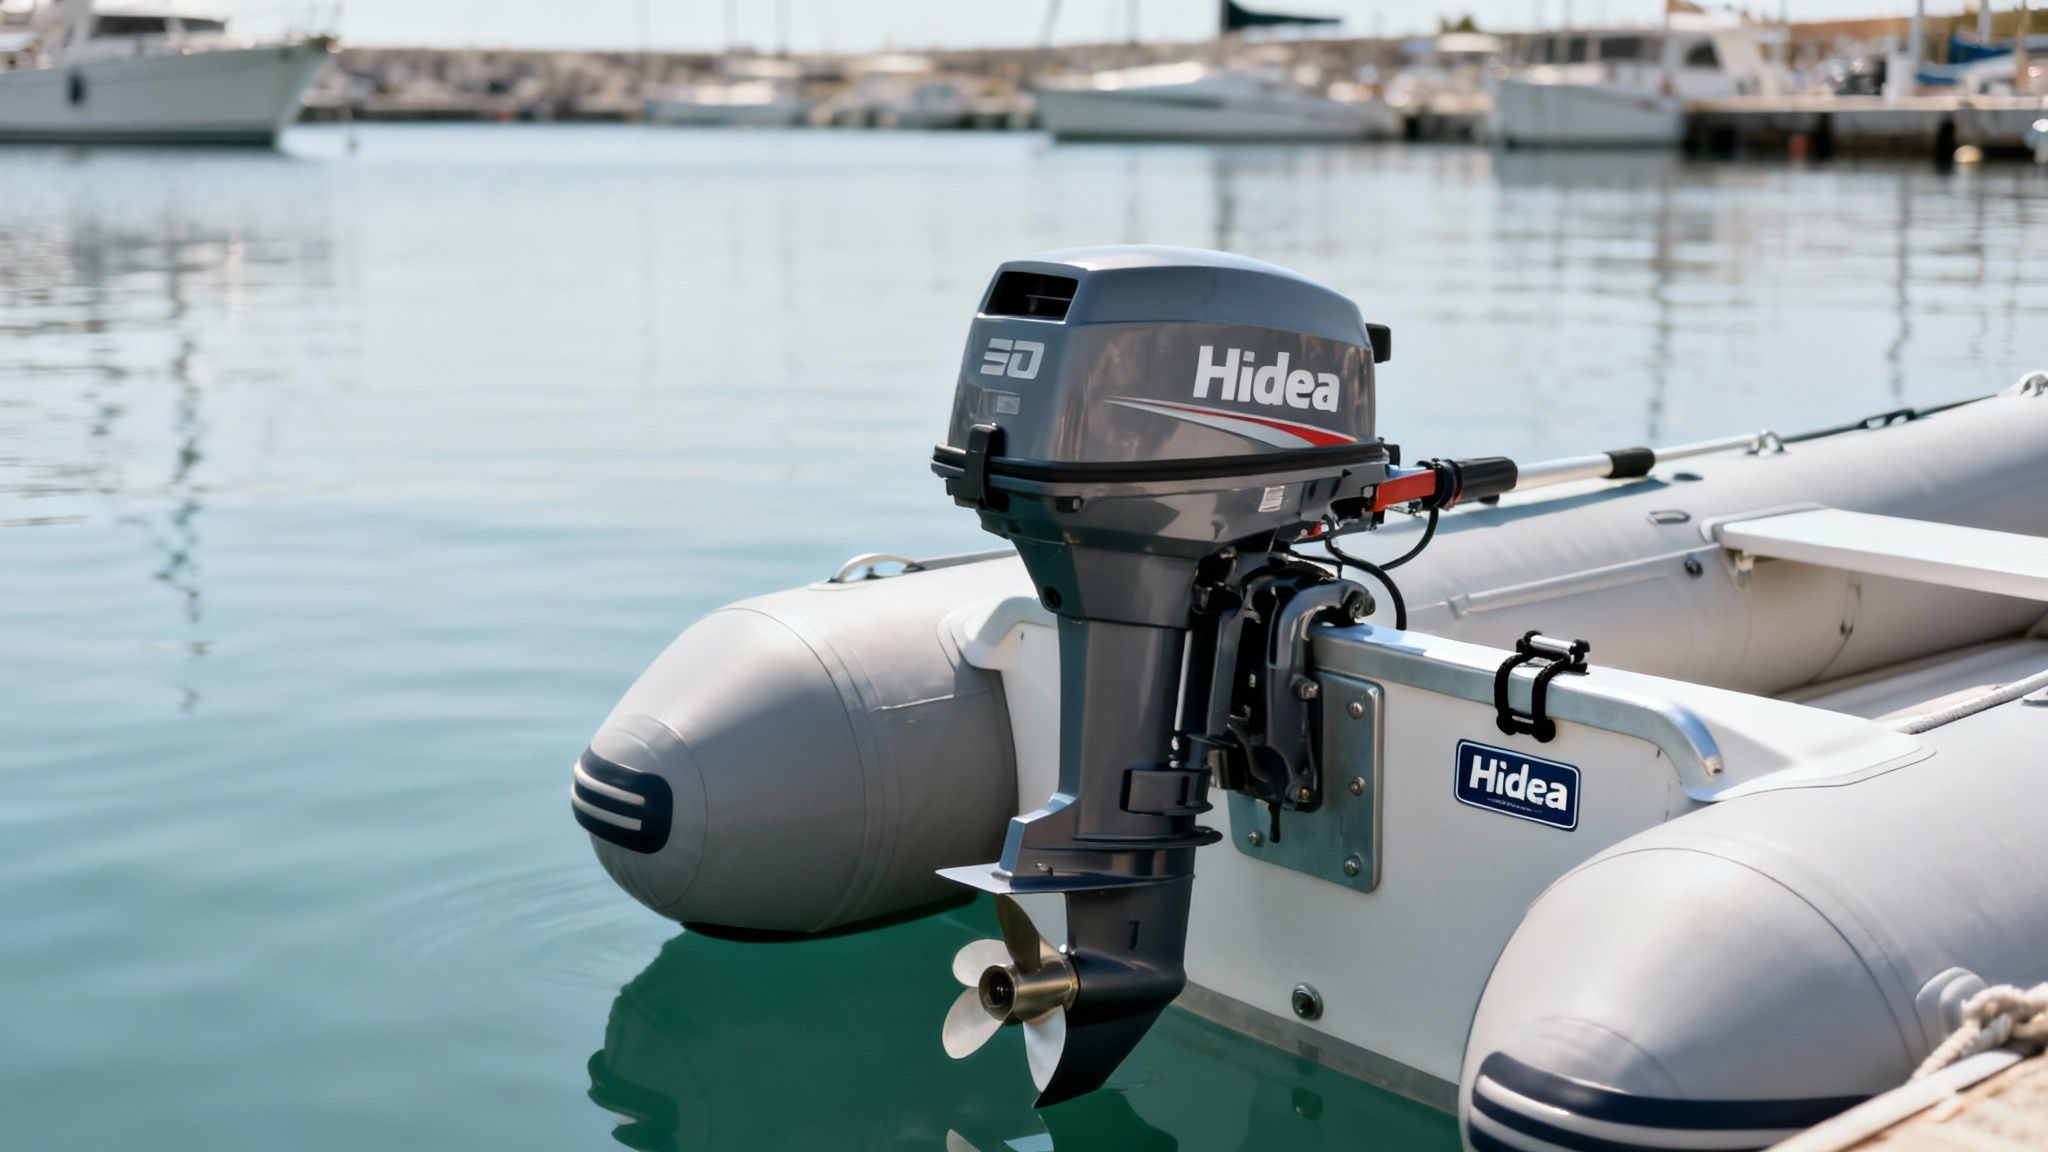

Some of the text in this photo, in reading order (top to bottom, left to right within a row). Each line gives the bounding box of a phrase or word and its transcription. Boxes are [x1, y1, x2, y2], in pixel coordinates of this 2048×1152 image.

[980, 338, 1045, 380] 30
[1193, 345, 1340, 413] Hidea
[1469, 755, 1568, 811] Hidea
